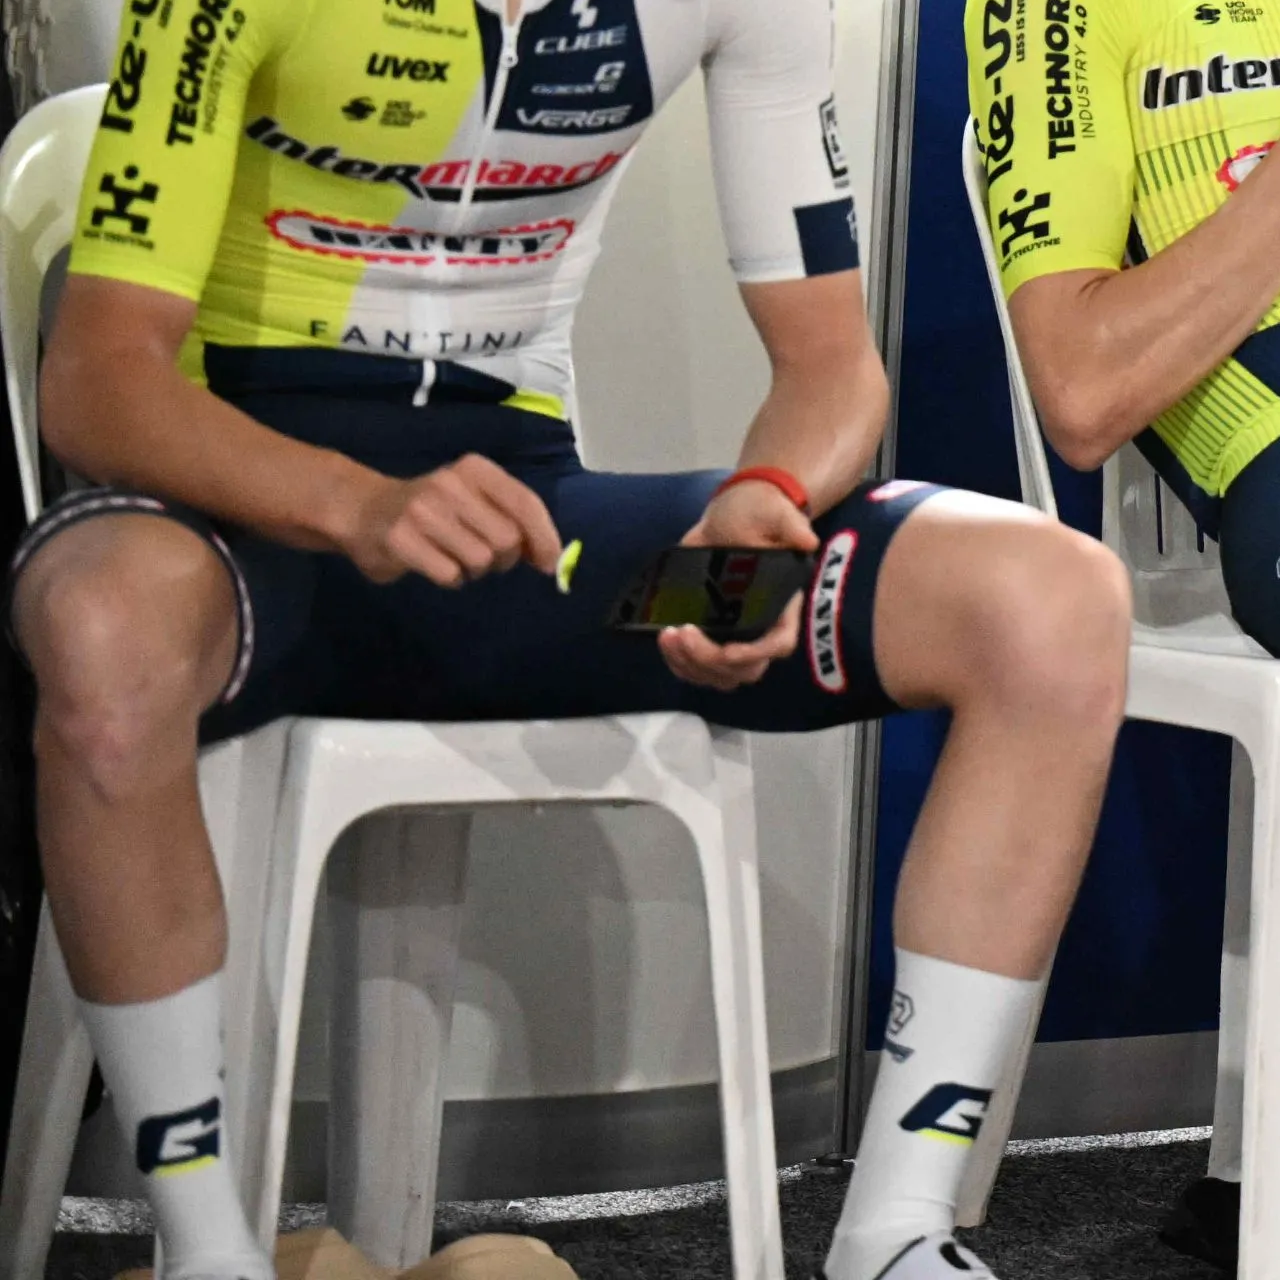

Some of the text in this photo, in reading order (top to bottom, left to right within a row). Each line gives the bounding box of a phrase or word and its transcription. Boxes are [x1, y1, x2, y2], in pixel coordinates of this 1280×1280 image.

[1016, 16, 1026, 33] IS
[534, 23, 628, 56] CUBE
[1016, 37, 1027, 63] LESS
[365, 52, 450, 84] uvex
[1074, 3, 1096, 140] INDUSTRY 4.0
[515, 103, 634, 129] VERGE
[245, 114, 631, 201] Intermarch
[1014, 236, 1061, 261] THUYNE
